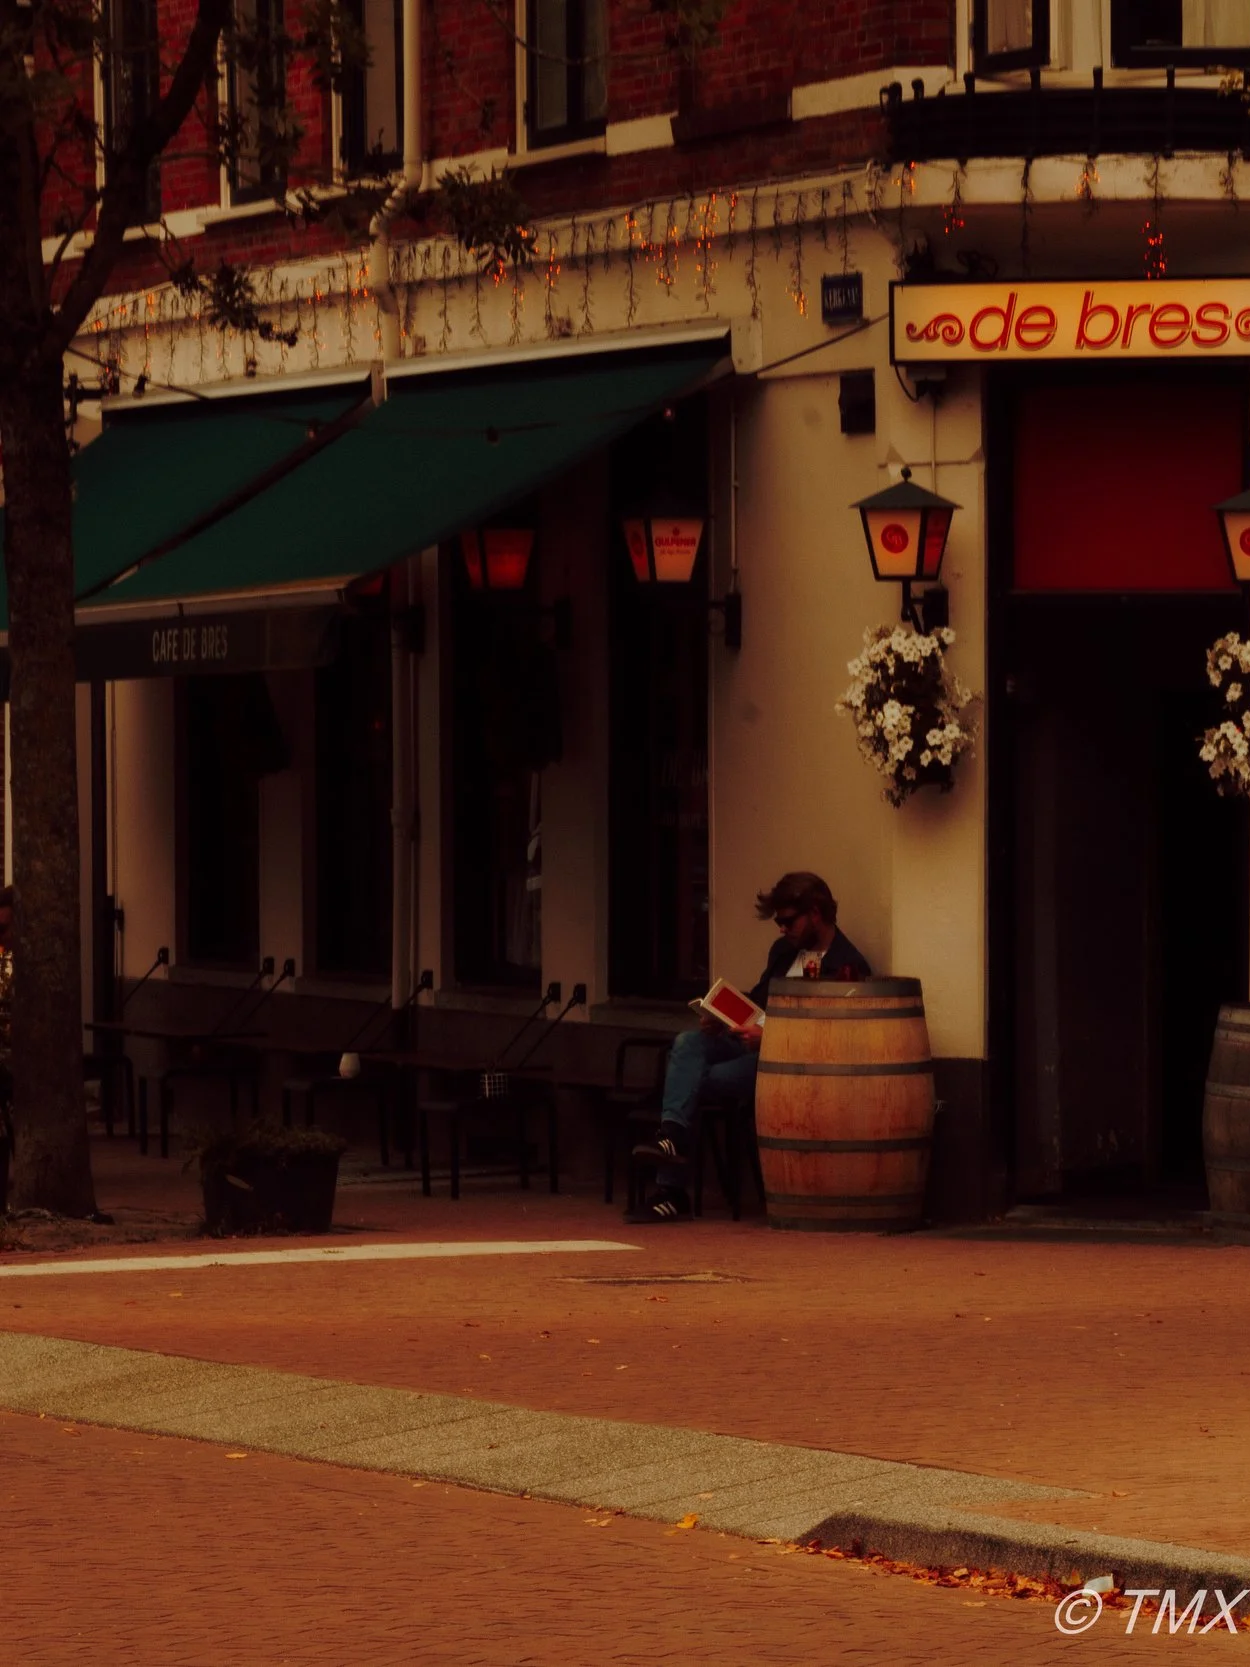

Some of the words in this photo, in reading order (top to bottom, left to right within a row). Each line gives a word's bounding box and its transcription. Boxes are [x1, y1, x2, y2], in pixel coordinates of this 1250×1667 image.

[969, 291, 1058, 352] de
[1075, 291, 1233, 349] bres
[152, 628, 179, 662] CAFE
[182, 627, 197, 660] DE
[201, 624, 228, 660] BRES
